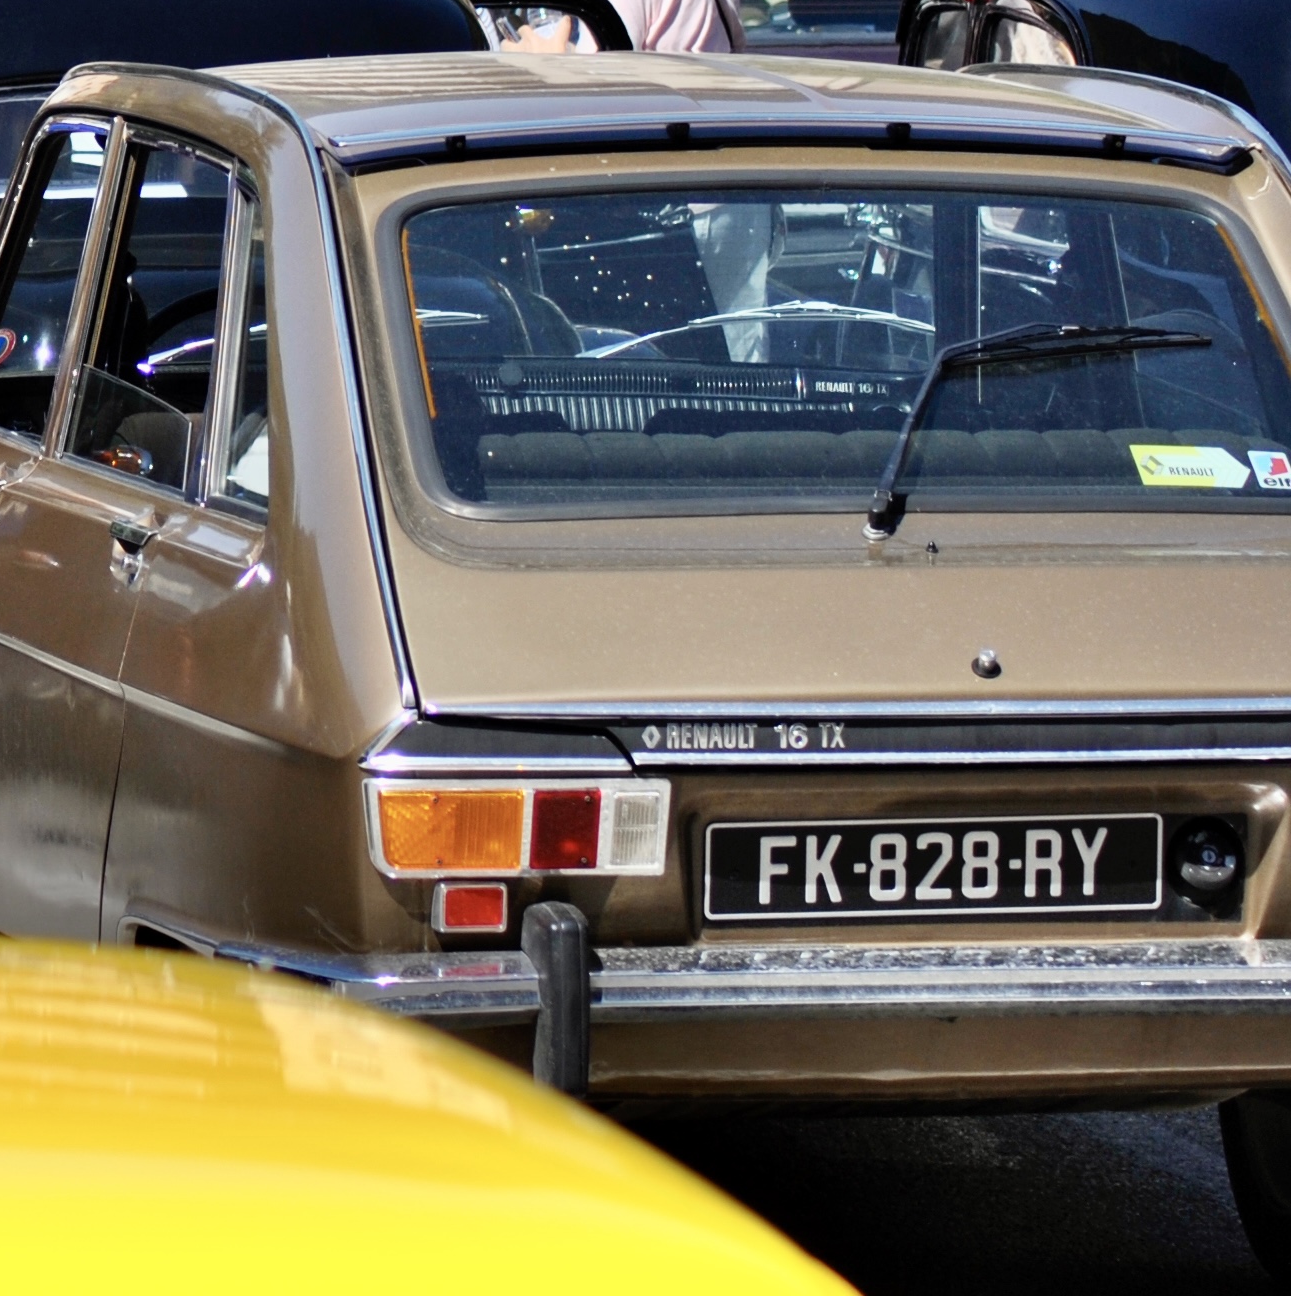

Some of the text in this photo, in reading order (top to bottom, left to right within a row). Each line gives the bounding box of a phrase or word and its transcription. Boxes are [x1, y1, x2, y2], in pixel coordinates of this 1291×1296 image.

[815, 381, 853, 394] RENAULT
[1168, 466, 1215, 477] RENAULT
[666, 722, 846, 750] RENAULT 16 TX
[758, 826, 1109, 905] FK-828-RY
